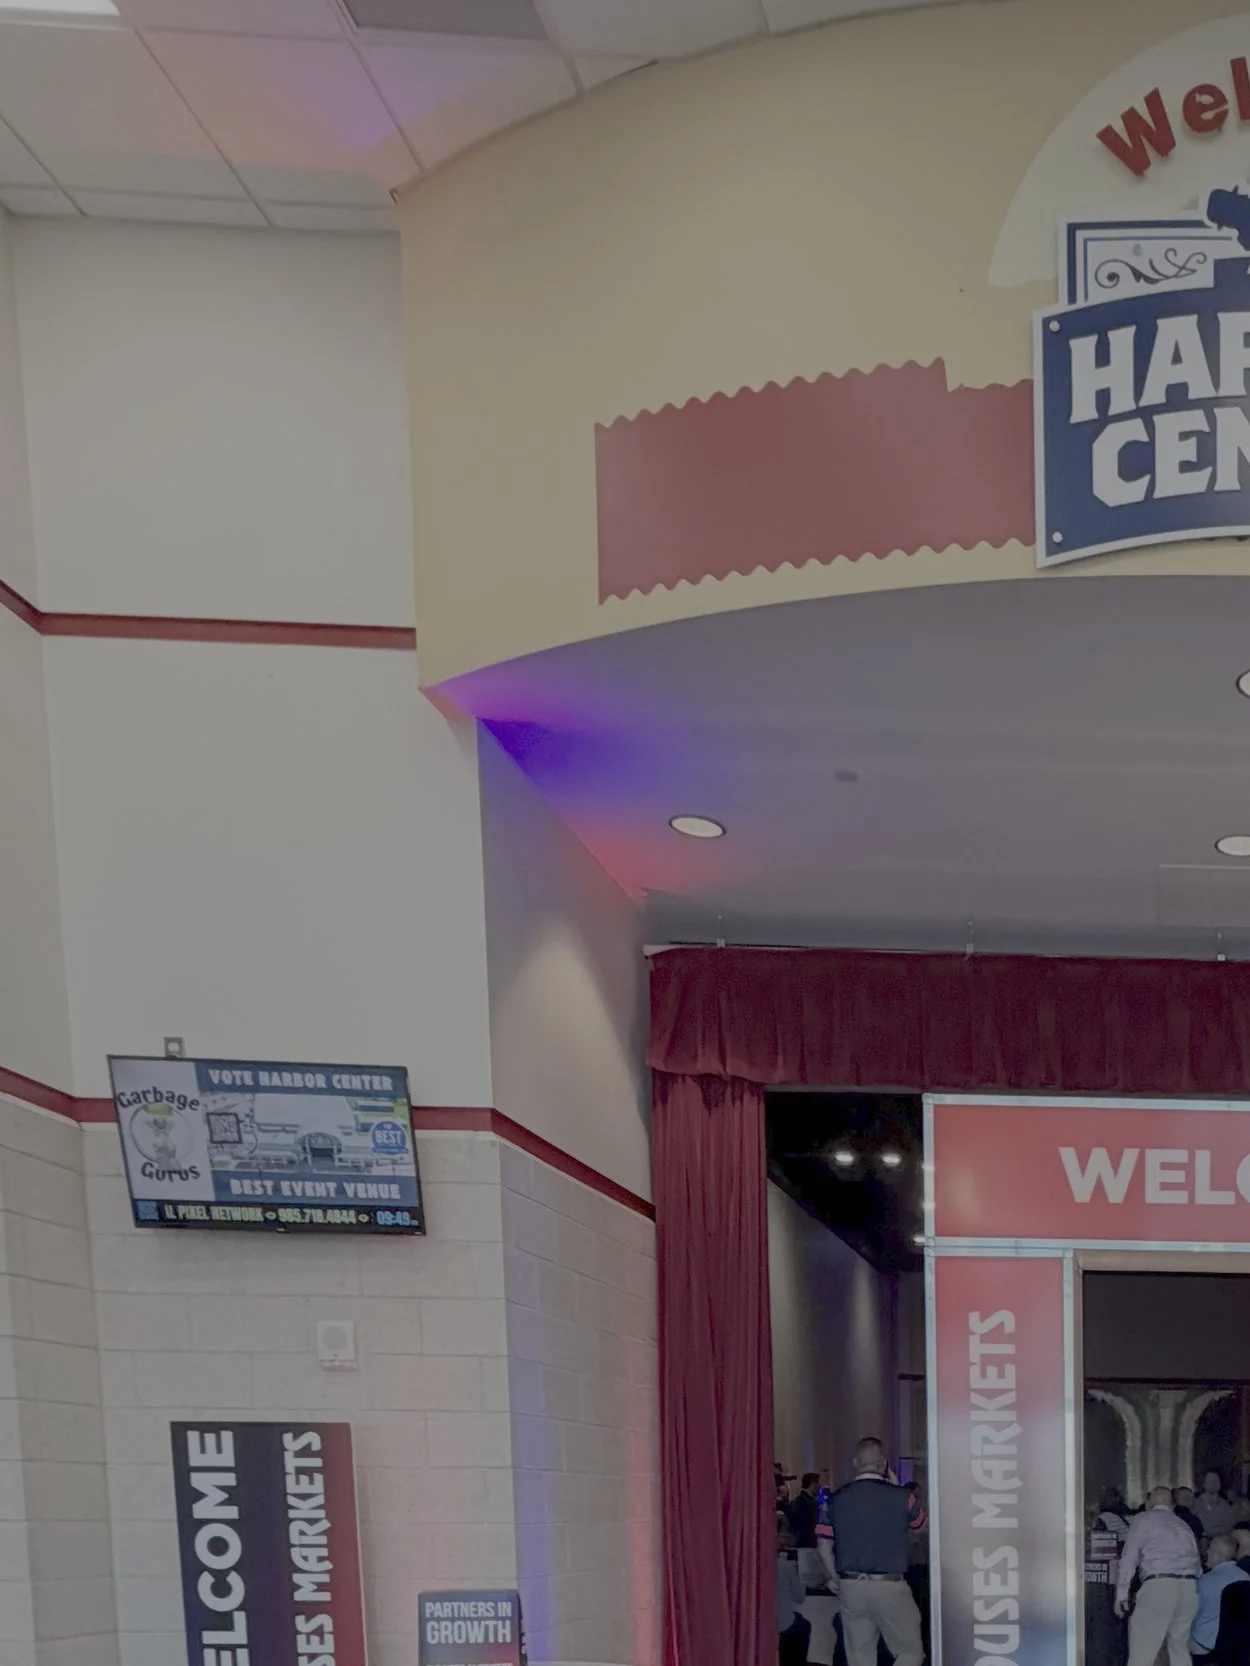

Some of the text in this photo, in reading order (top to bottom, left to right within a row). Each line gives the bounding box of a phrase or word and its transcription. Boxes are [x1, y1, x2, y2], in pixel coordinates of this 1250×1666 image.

[208, 1069, 393, 1091] VOTE HARBOR CENTER
[117, 1086, 200, 1111] Garbage
[375, 1130, 403, 1147] BEST
[141, 1162, 200, 1182] Gurus
[229, 1179, 401, 1199] BEST EVENT VENUE
[210, 1206, 263, 1221] NETWORK
[968, 1309, 1023, 1529] MARKETS
[283, 1431, 333, 1602] MARKETS
[425, 1602, 512, 1618] PARTNERS IN
[426, 1620, 512, 1644] GROWTH
